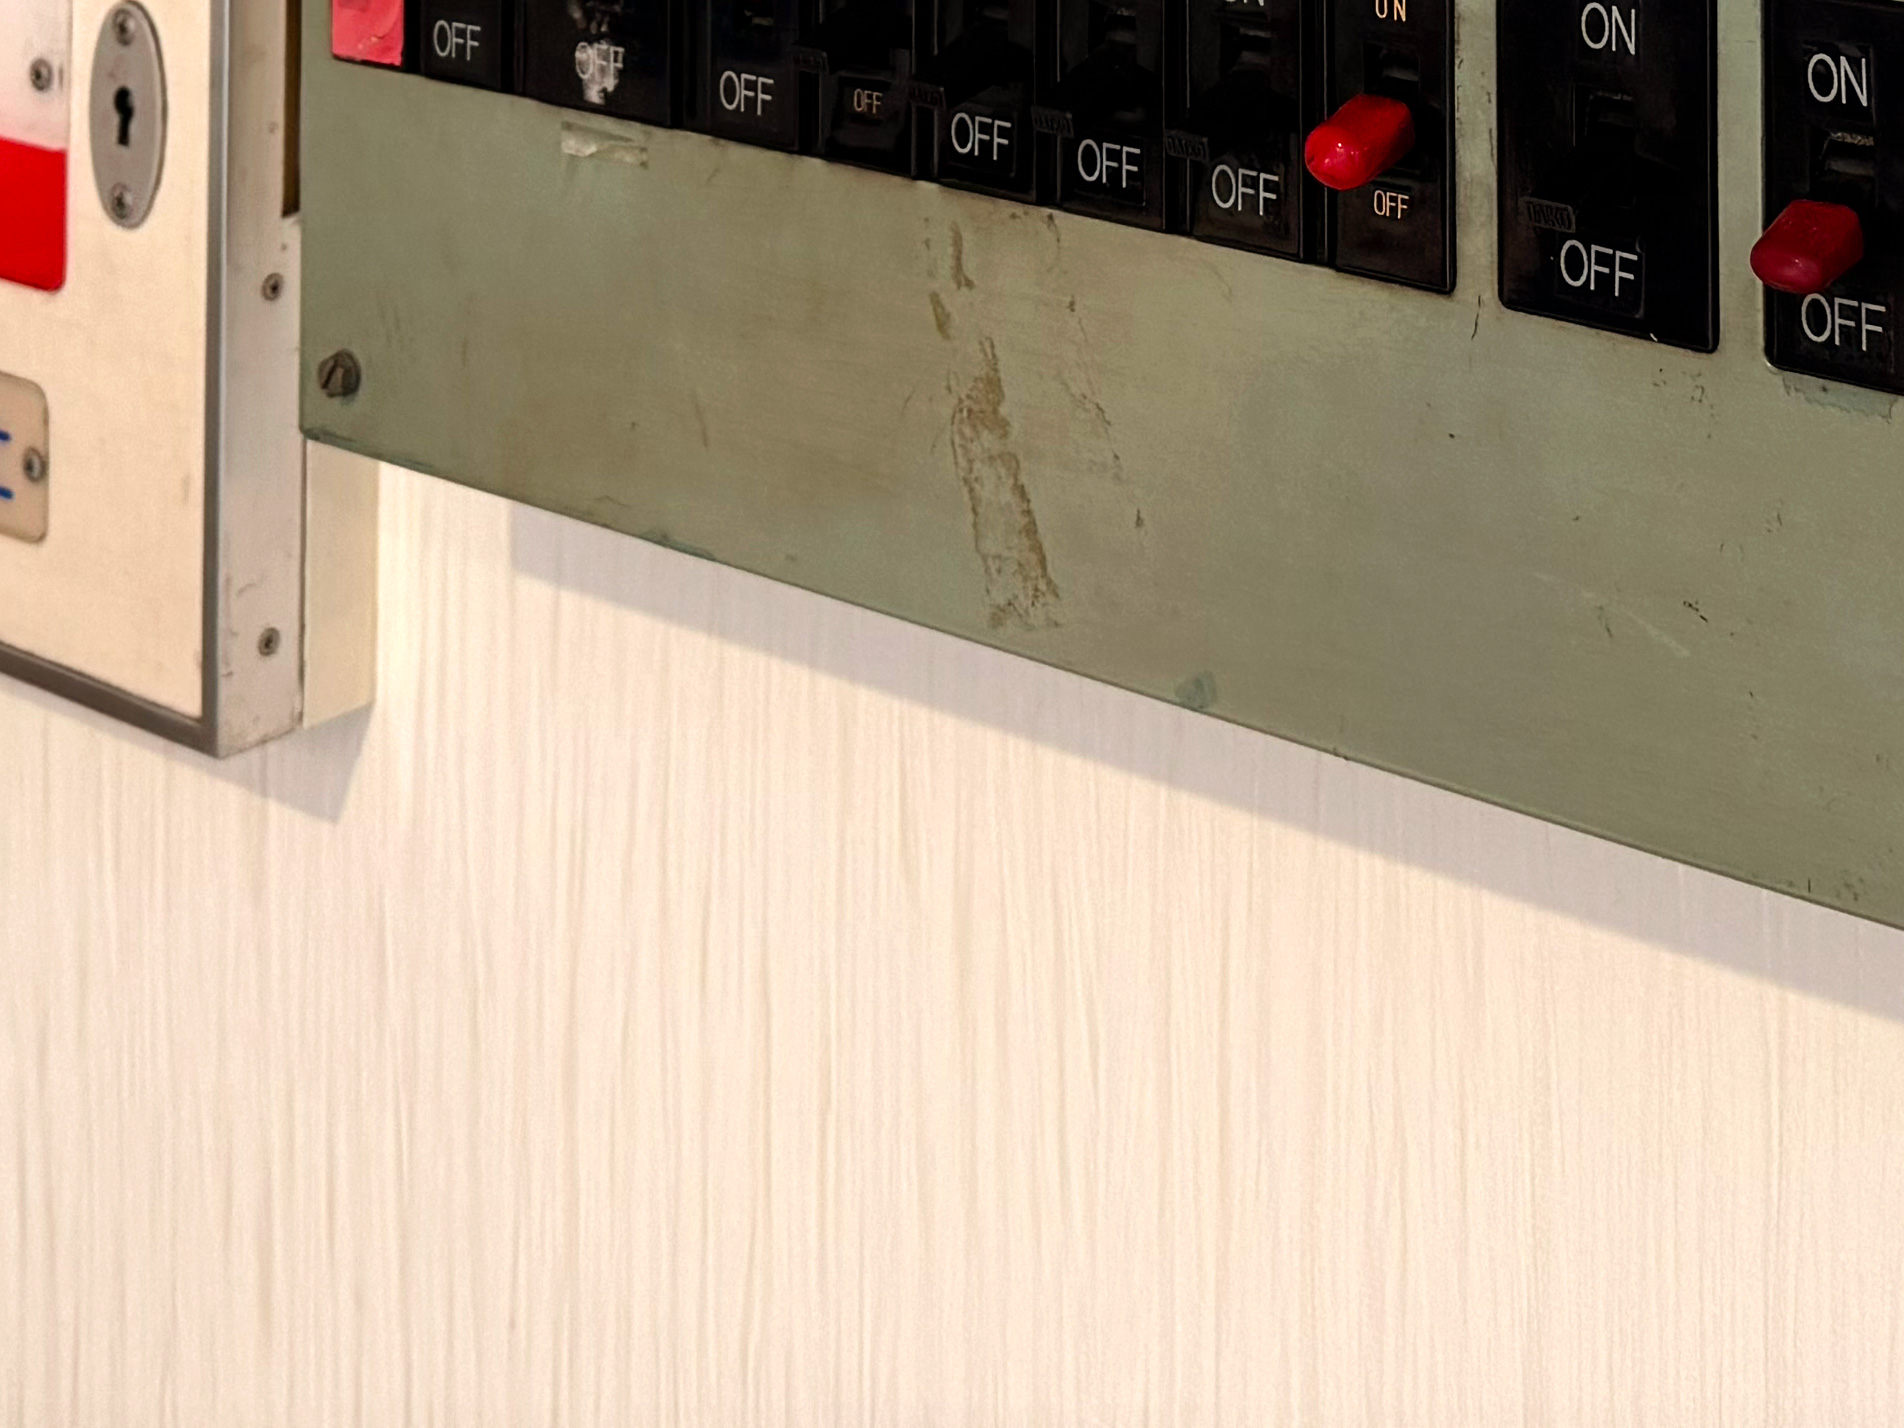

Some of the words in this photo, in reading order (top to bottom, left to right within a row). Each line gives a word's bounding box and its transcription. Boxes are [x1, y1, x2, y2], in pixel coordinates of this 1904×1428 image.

[433, 20, 481, 63] OFF
[1580, 1, 1637, 56] ON
[719, 69, 775, 116] OFF
[853, 87, 883, 115] OFF
[1807, 52, 1868, 108] ON
[950, 111, 1012, 162] OFF
[1077, 138, 1141, 190] OFF
[1211, 163, 1278, 217] OFF
[1373, 189, 1409, 220] OFF
[1559, 238, 1639, 298] OFF
[1800, 293, 1887, 352] OFF
